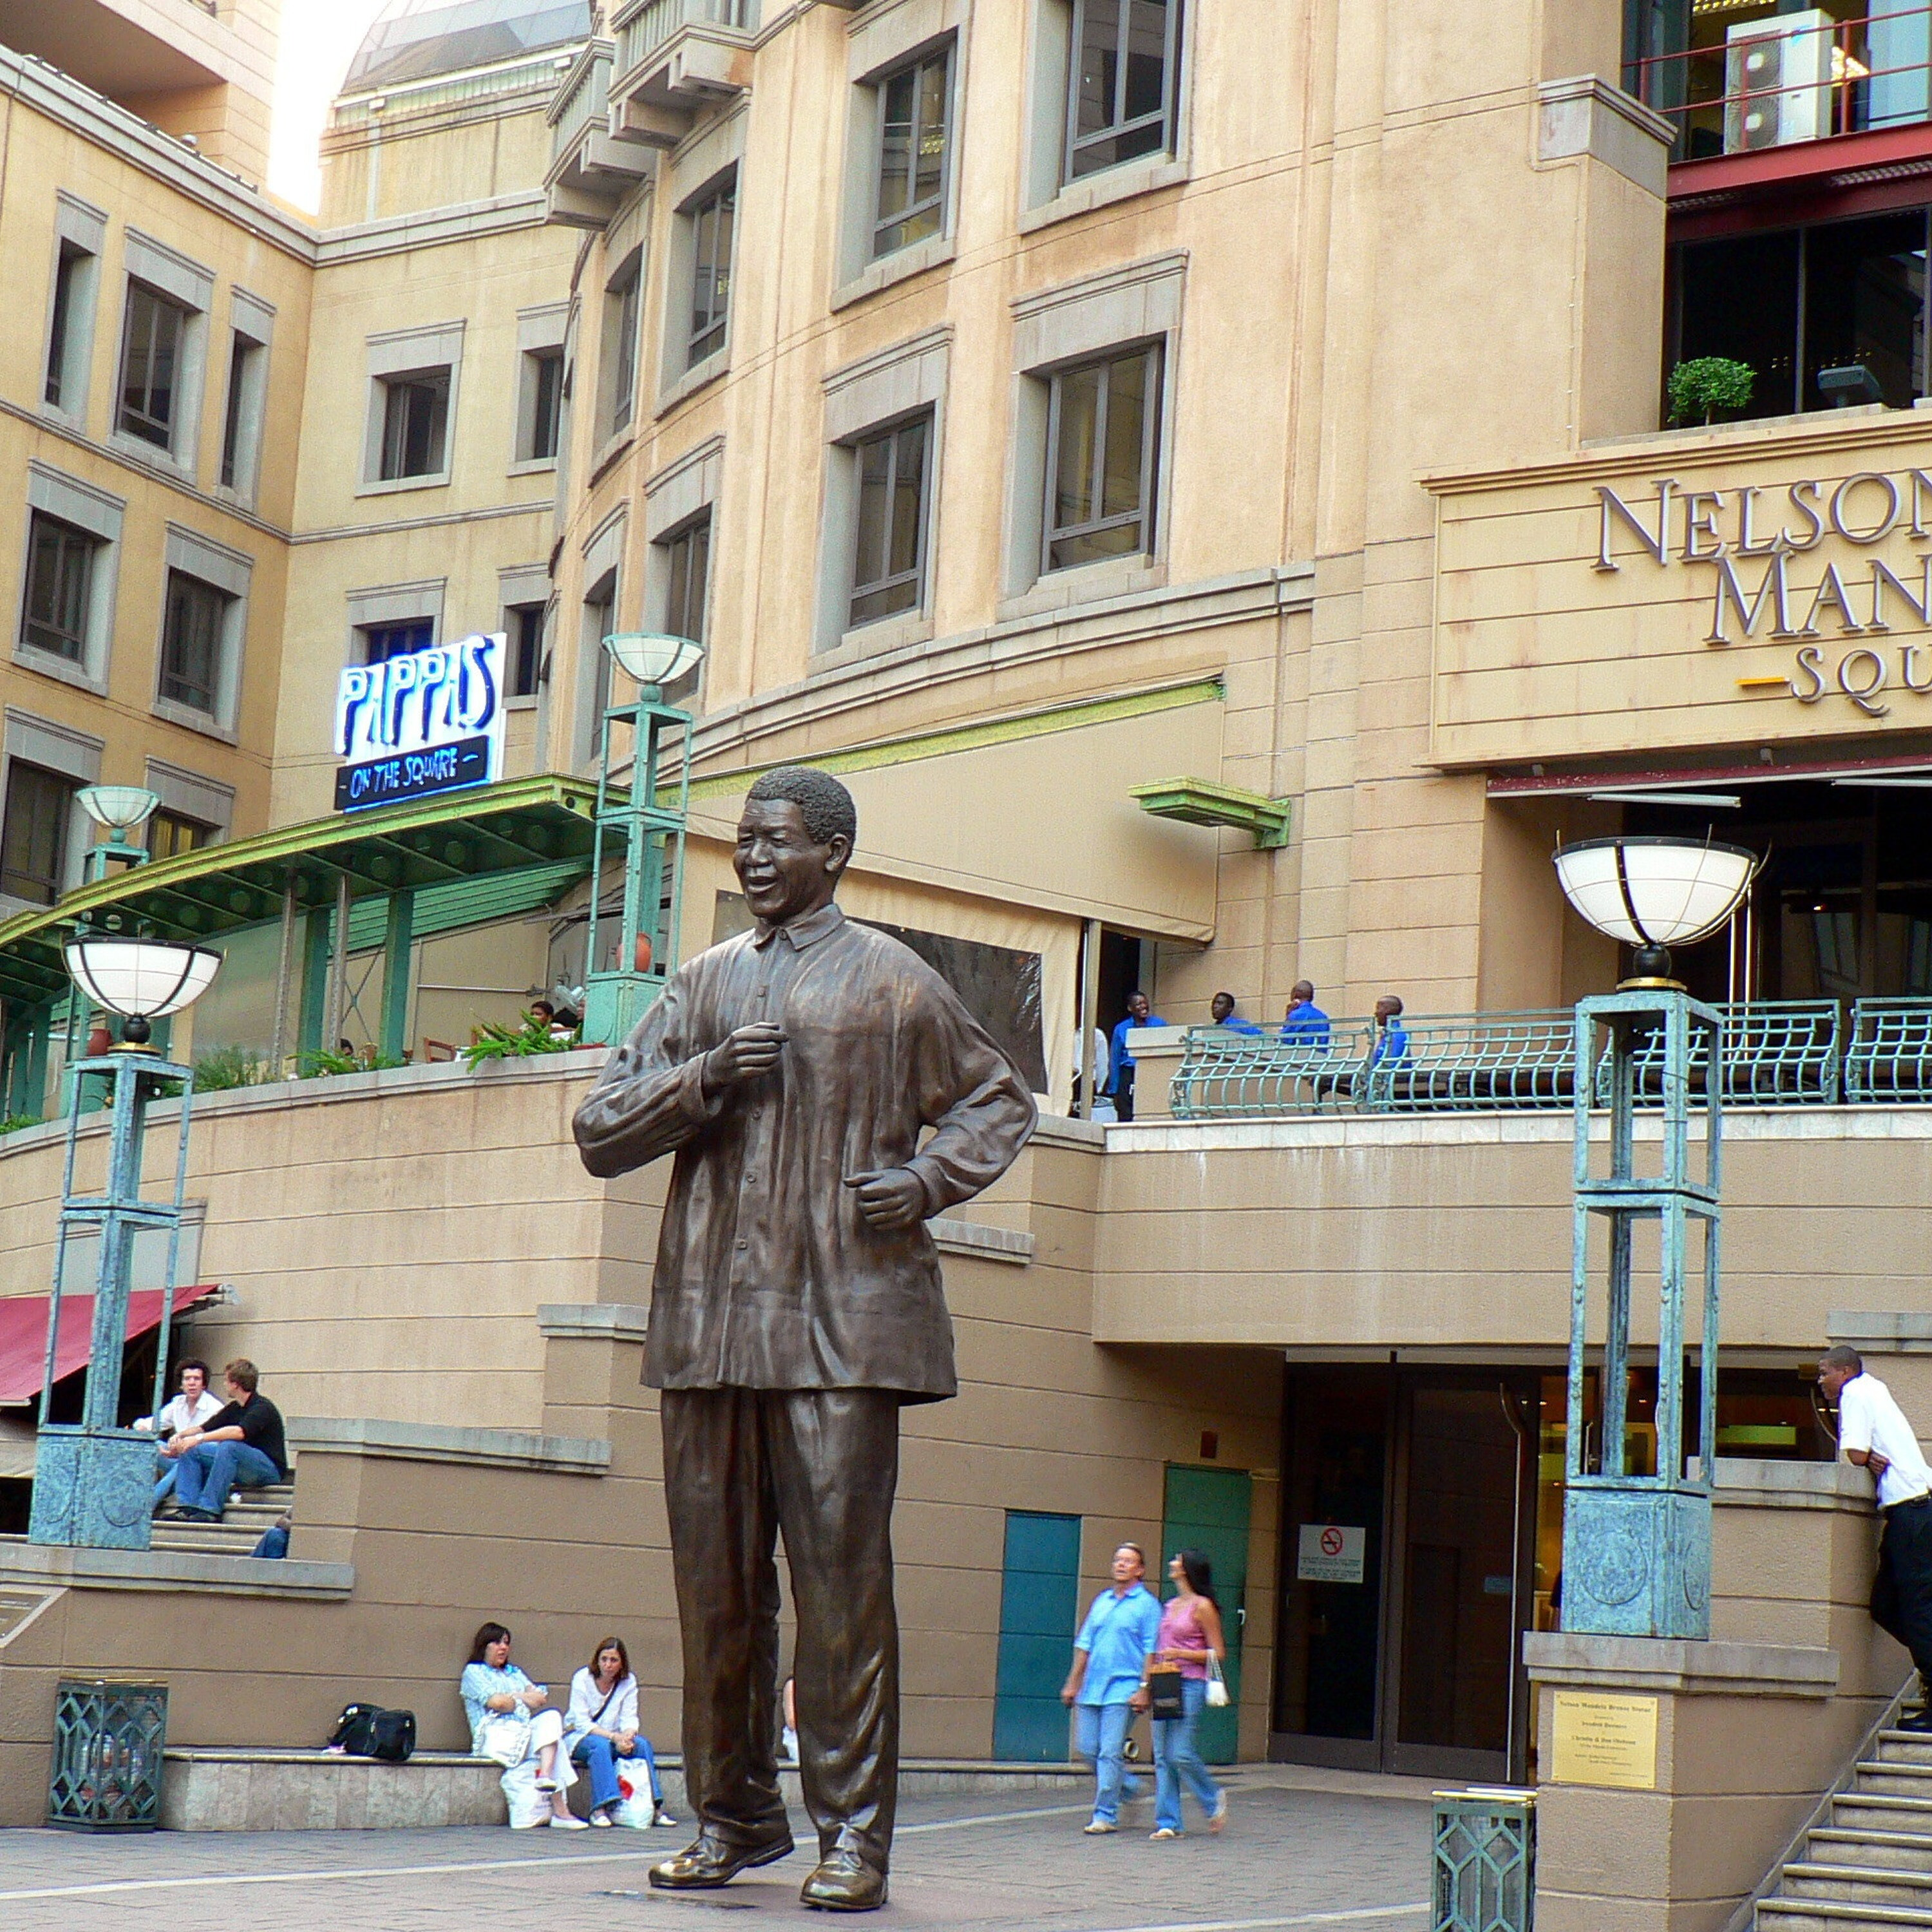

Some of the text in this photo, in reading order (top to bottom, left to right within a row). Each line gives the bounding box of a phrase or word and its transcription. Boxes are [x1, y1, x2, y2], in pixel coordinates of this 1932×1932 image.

[334, 634, 495, 757] PAPPAS
[350, 746, 458, 798] ON THE SQUARE
